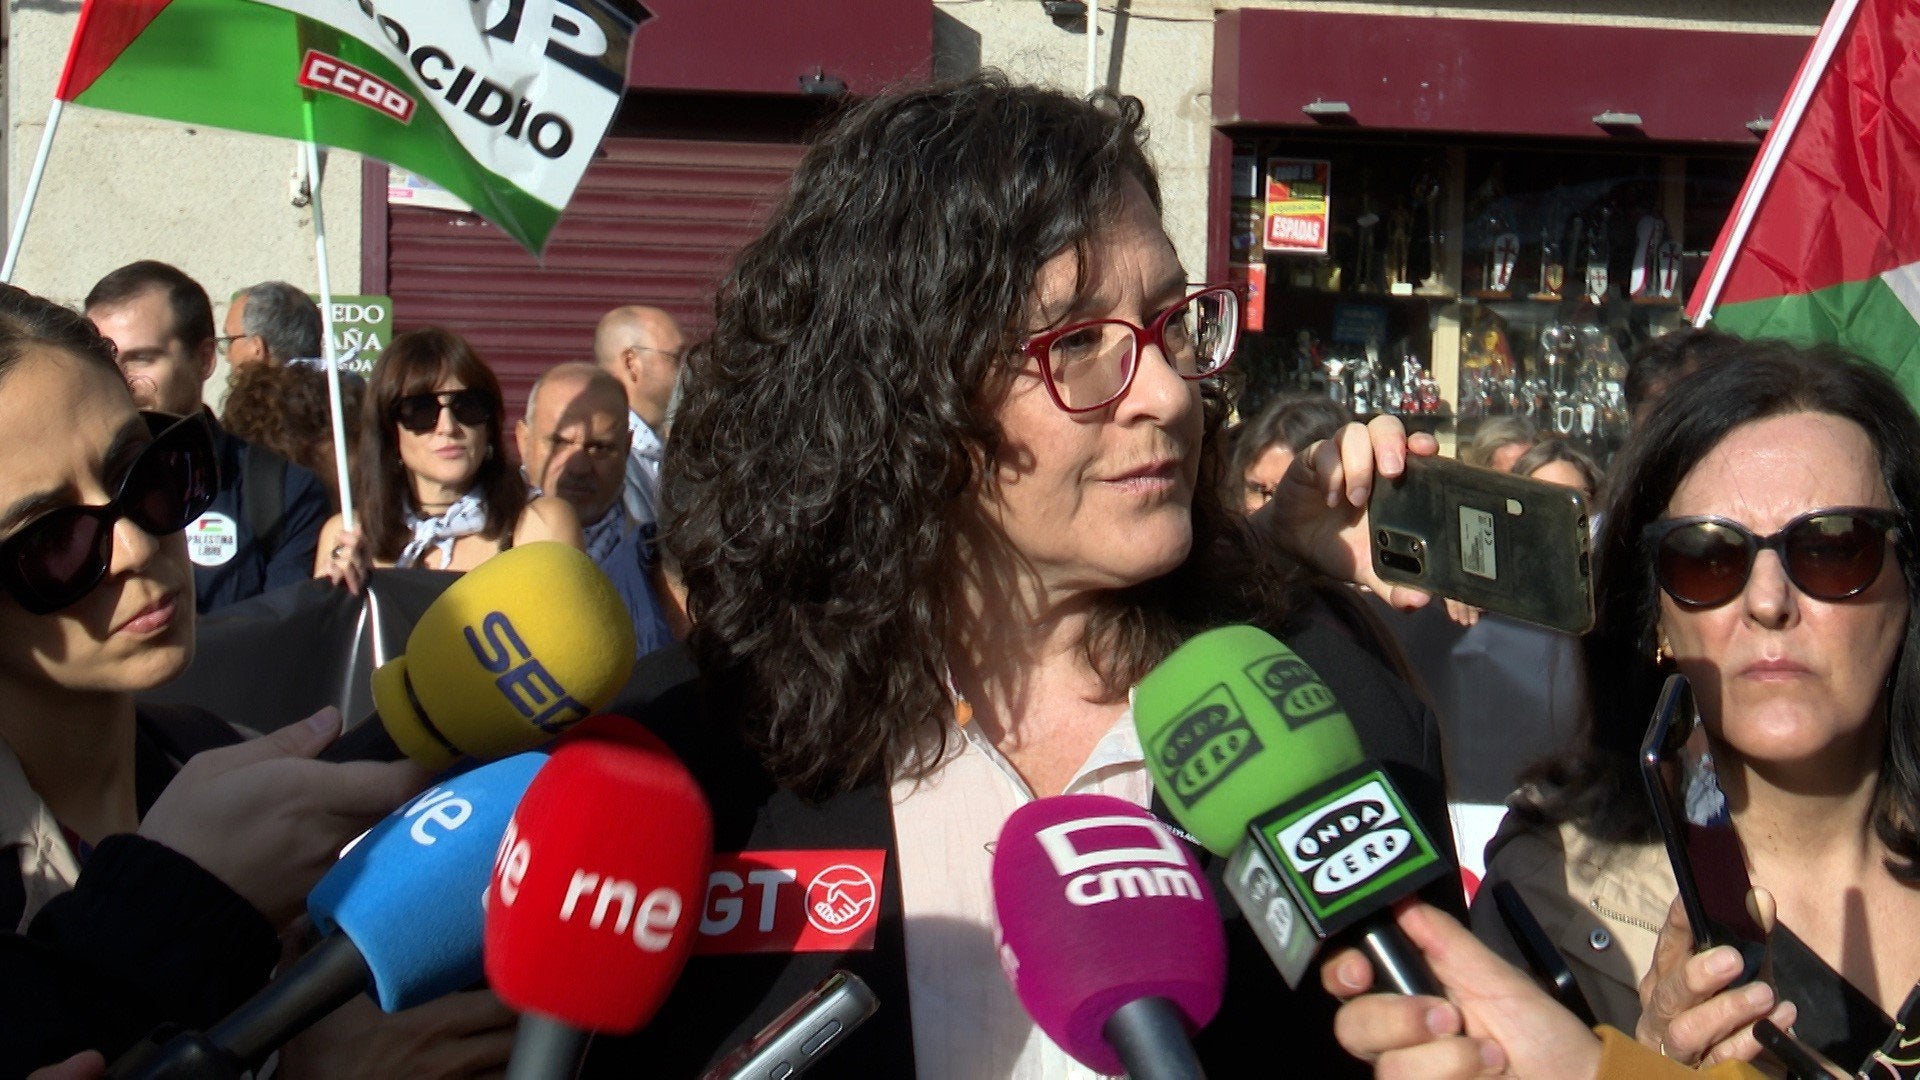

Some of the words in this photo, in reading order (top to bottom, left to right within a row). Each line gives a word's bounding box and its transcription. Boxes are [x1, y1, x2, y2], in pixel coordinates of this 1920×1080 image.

[308, 59, 408, 117] CCOO
[1271, 216, 1319, 242] ESPADAS
[317, 303, 385, 324] EDO
[1180, 734, 1240, 788] CERO
[400, 786, 473, 846] ve
[1300, 806, 1381, 855] ONDA
[1327, 834, 1396, 882] CERO
[558, 867, 682, 952] rne
[699, 869, 797, 935] GT
[1065, 866, 1204, 907] cmm
